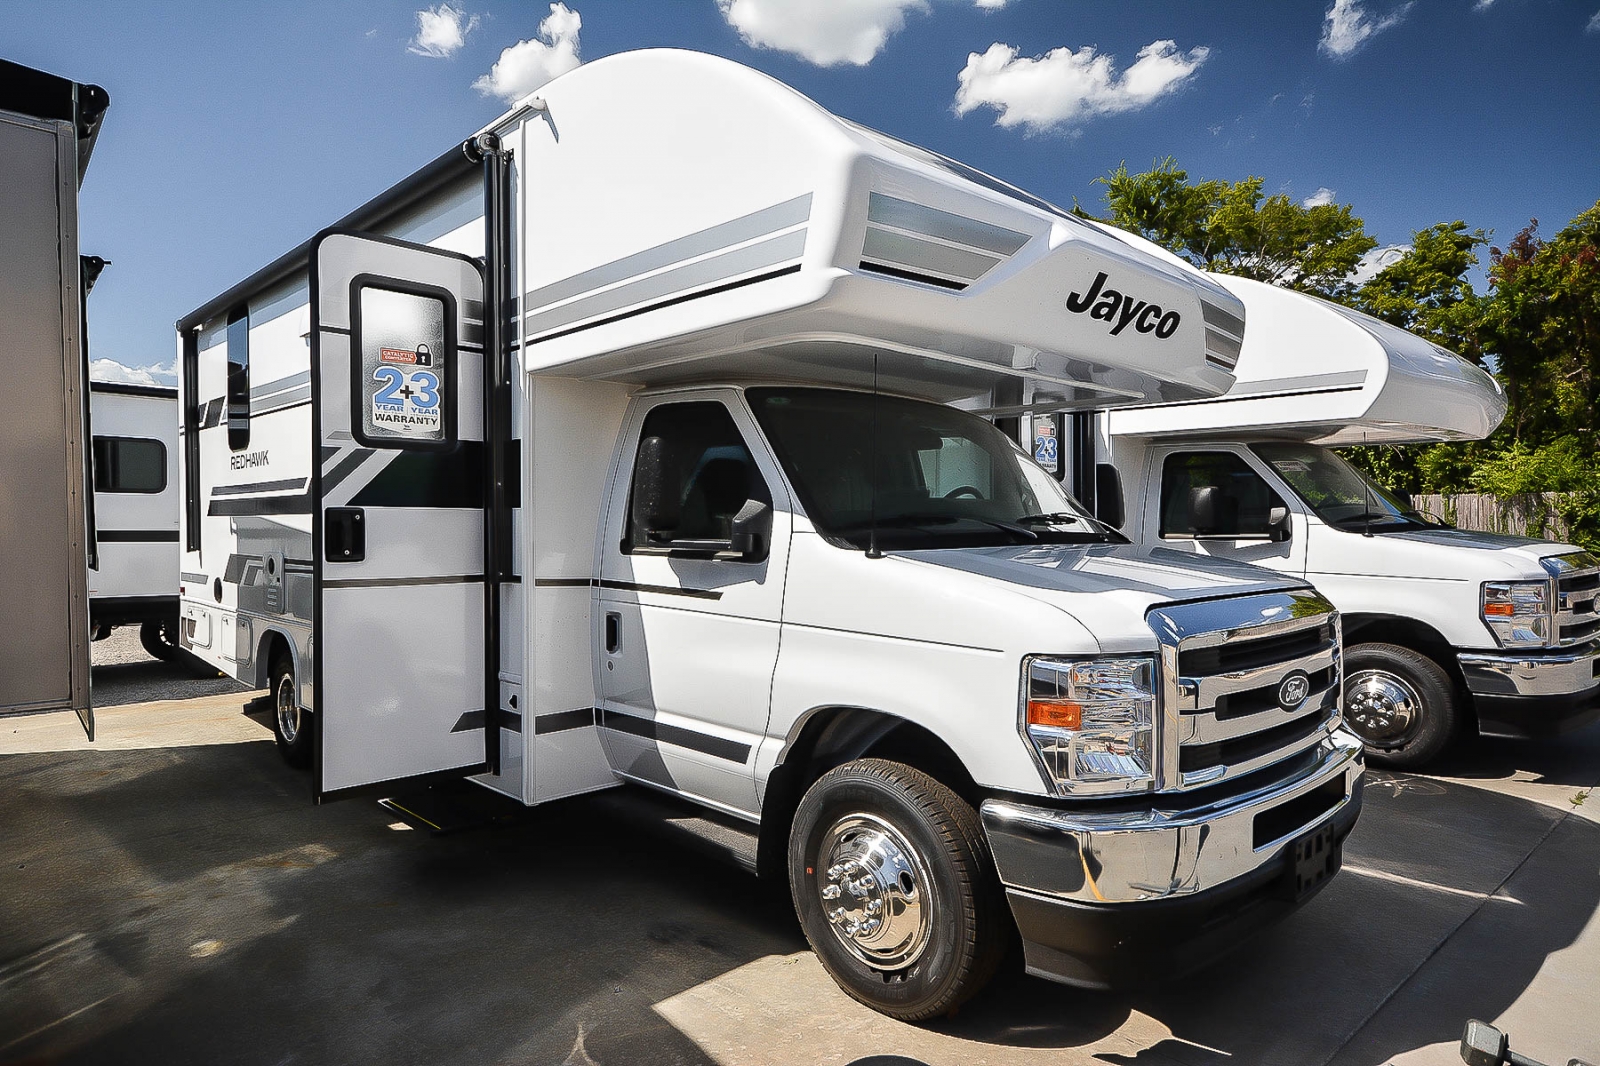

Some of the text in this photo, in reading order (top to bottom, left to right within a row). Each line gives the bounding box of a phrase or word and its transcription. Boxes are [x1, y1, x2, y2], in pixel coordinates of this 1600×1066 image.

[1066, 271, 1181, 339] Jayco
[374, 413, 438, 426] WARRANTY
[375, 404, 404, 412] YEAR
[410, 407, 438, 415] YEAR
[230, 449, 270, 471] REDHAWK
[1286, 680, 1304, 702] Ford
